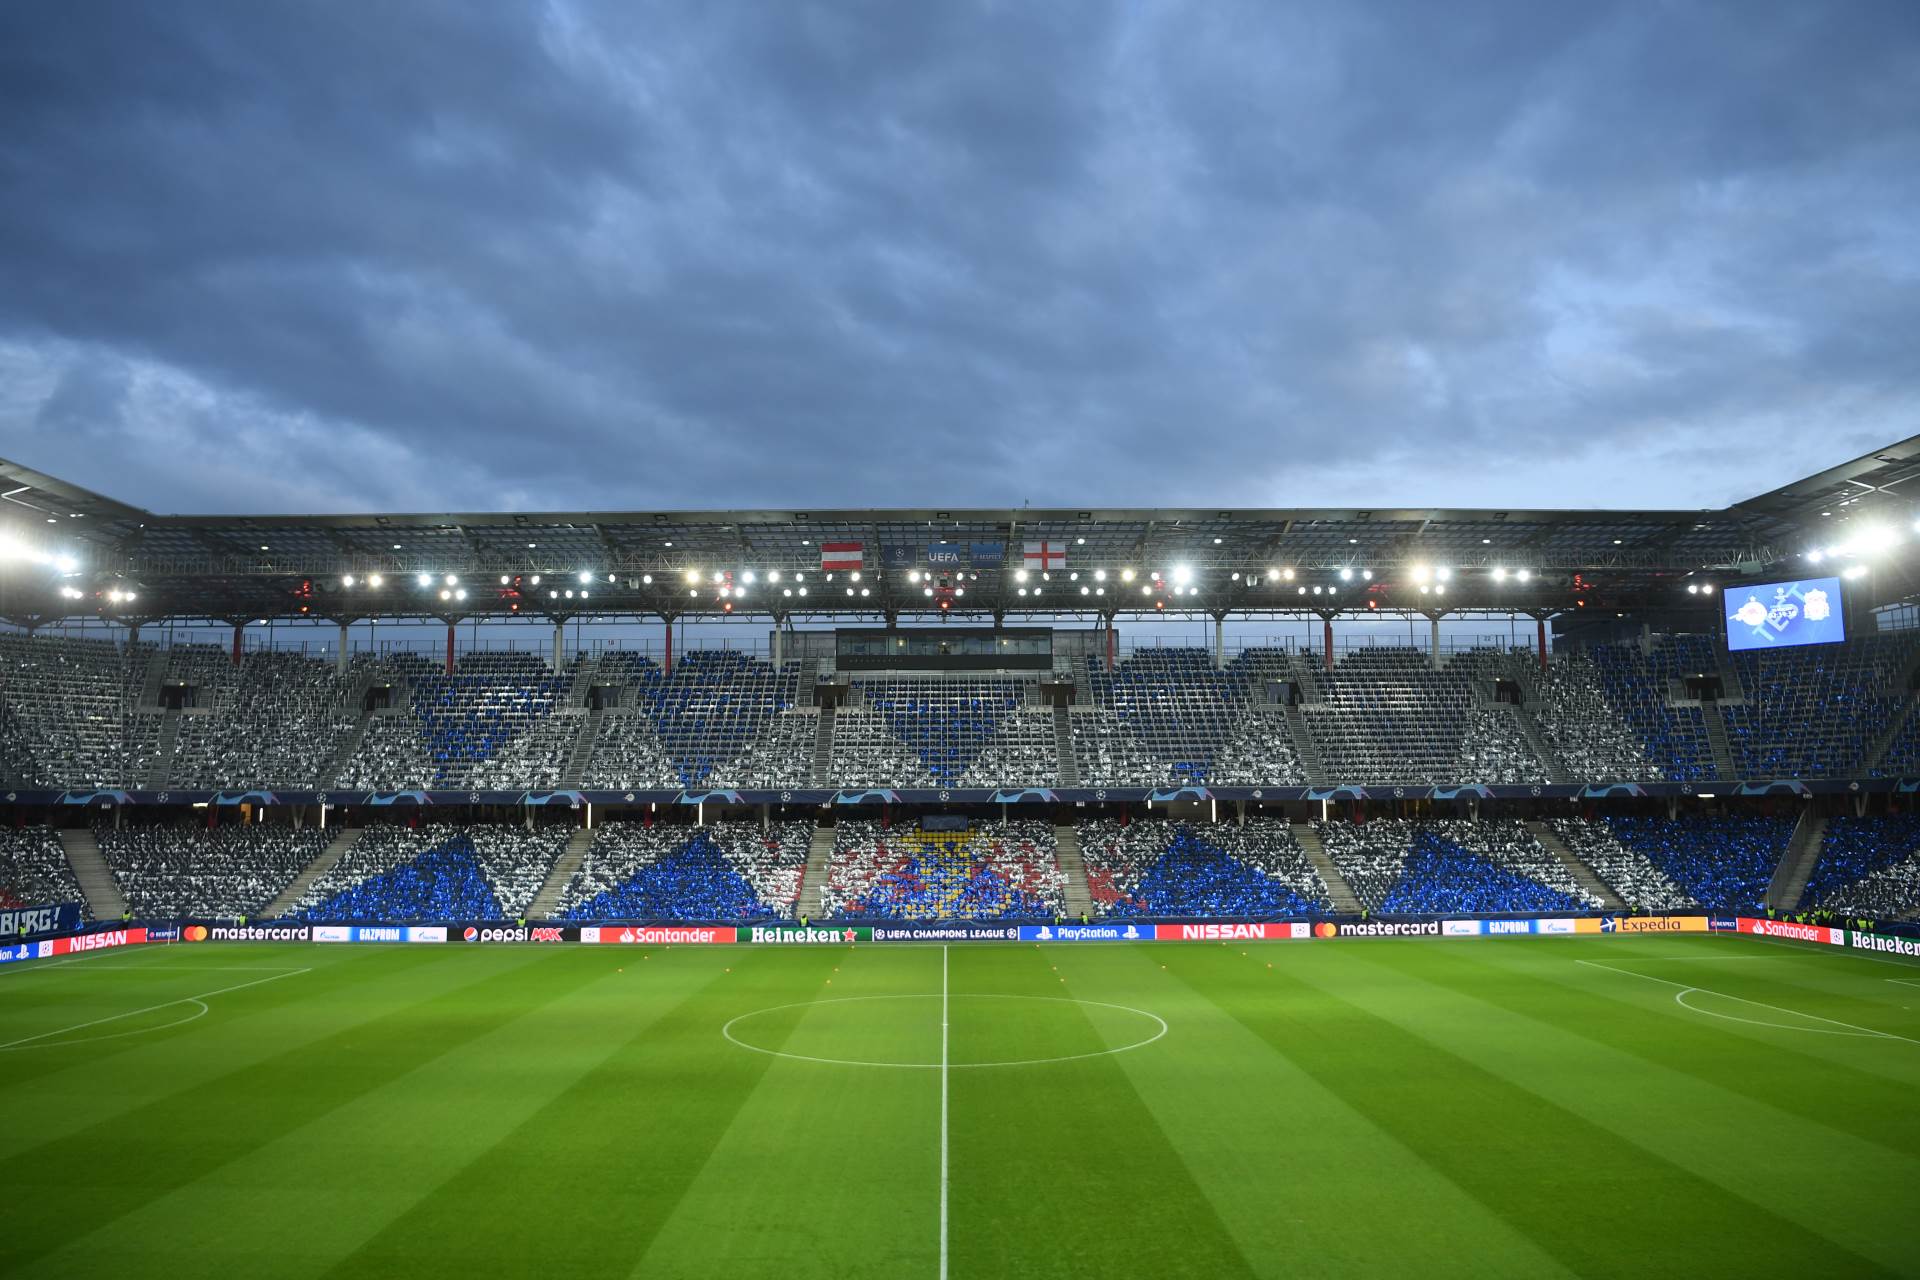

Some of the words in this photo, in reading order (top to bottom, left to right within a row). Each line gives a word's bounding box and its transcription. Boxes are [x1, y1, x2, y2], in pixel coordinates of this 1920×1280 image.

[929, 552, 959, 562] UEFA
[1183, 924, 1265, 938] NISSAN
[1340, 920, 1438, 936] mastercard
[1489, 921, 1529, 934] GAZPROM
[1622, 917, 1681, 931] Expedia
[1766, 920, 1819, 941] Santander
[212, 925, 309, 941] mastercard
[359, 928, 400, 941] GAZPROM
[481, 927, 528, 942] pepsi
[531, 927, 563, 942] MAX
[636, 927, 717, 942] Santander
[751, 927, 841, 943] Heineken
[887, 930, 912, 938] UEFA
[913, 930, 967, 938] CHAMPIONS
[970, 930, 1005, 938] LEAGUE
[1058, 927, 1119, 940] PlayStation
[69, 930, 127, 953] NISSAN
